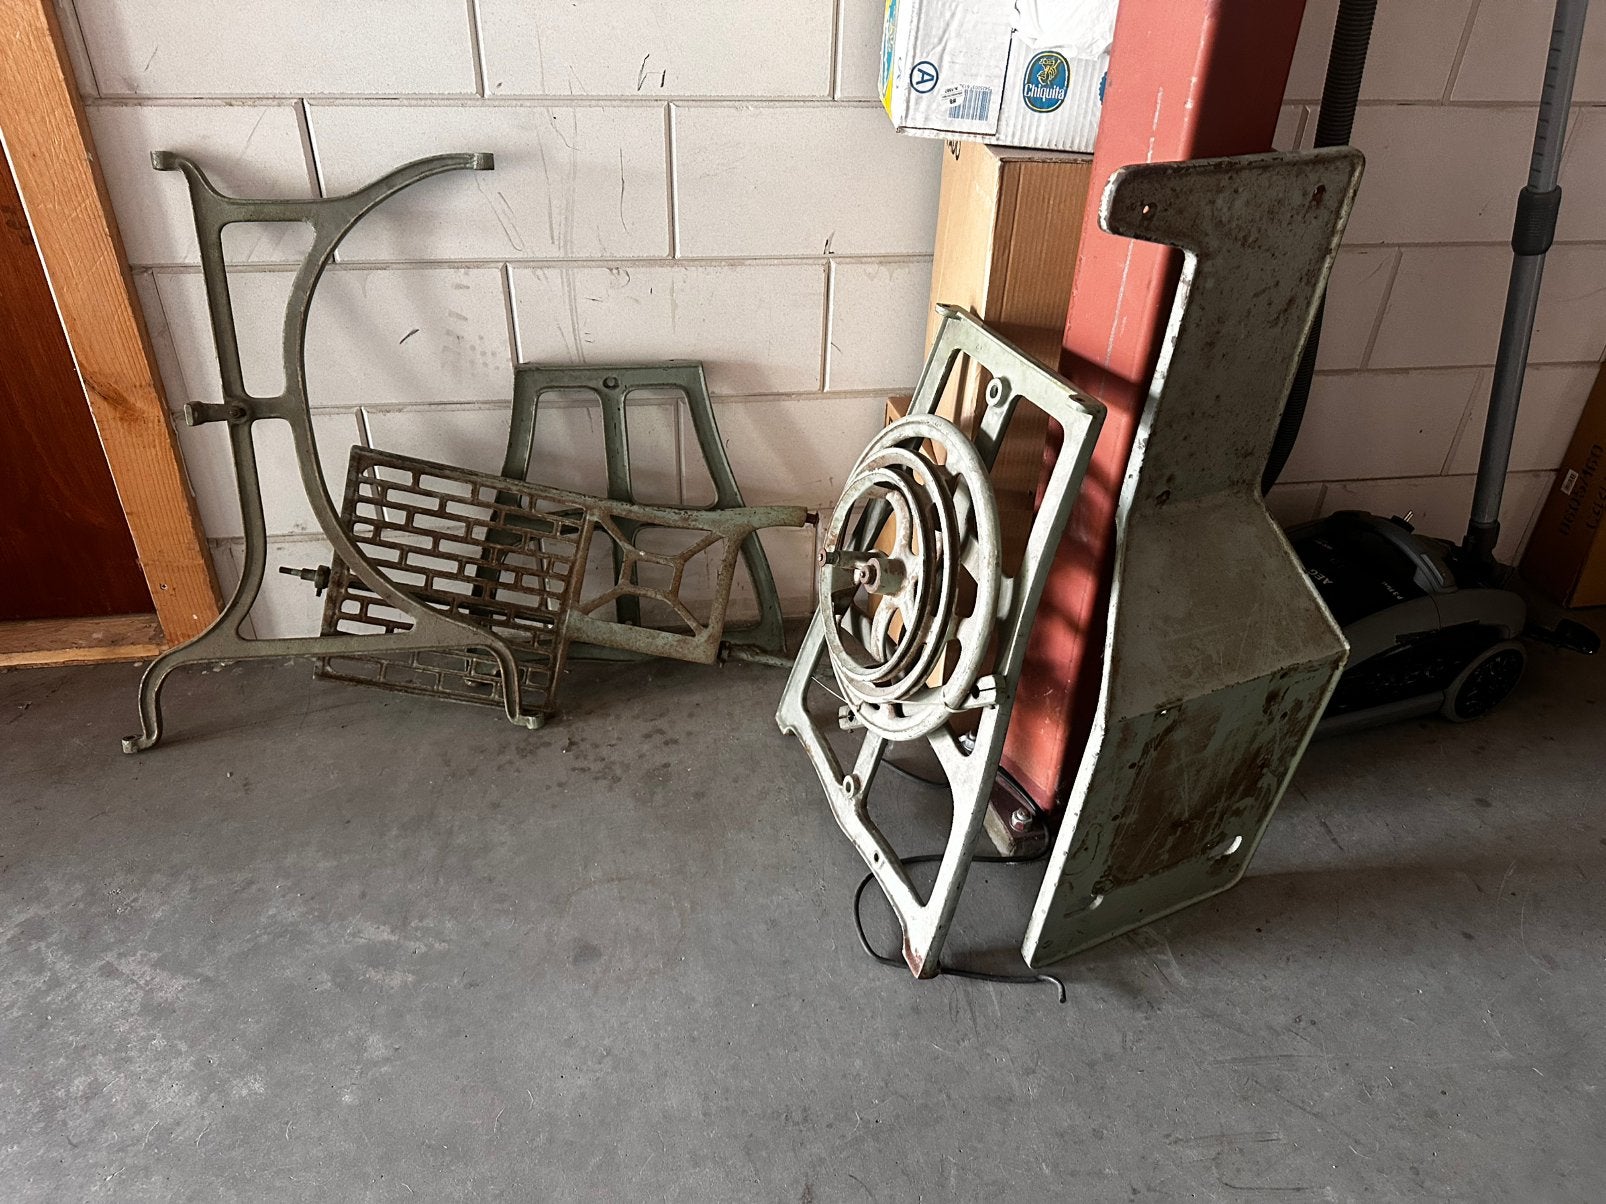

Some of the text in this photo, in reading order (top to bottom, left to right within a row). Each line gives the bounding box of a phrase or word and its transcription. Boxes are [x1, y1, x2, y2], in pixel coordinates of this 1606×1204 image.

[916, 68, 935, 85] A
[1023, 83, 1066, 102] Chiquita
[1308, 568, 1334, 585] AEG
